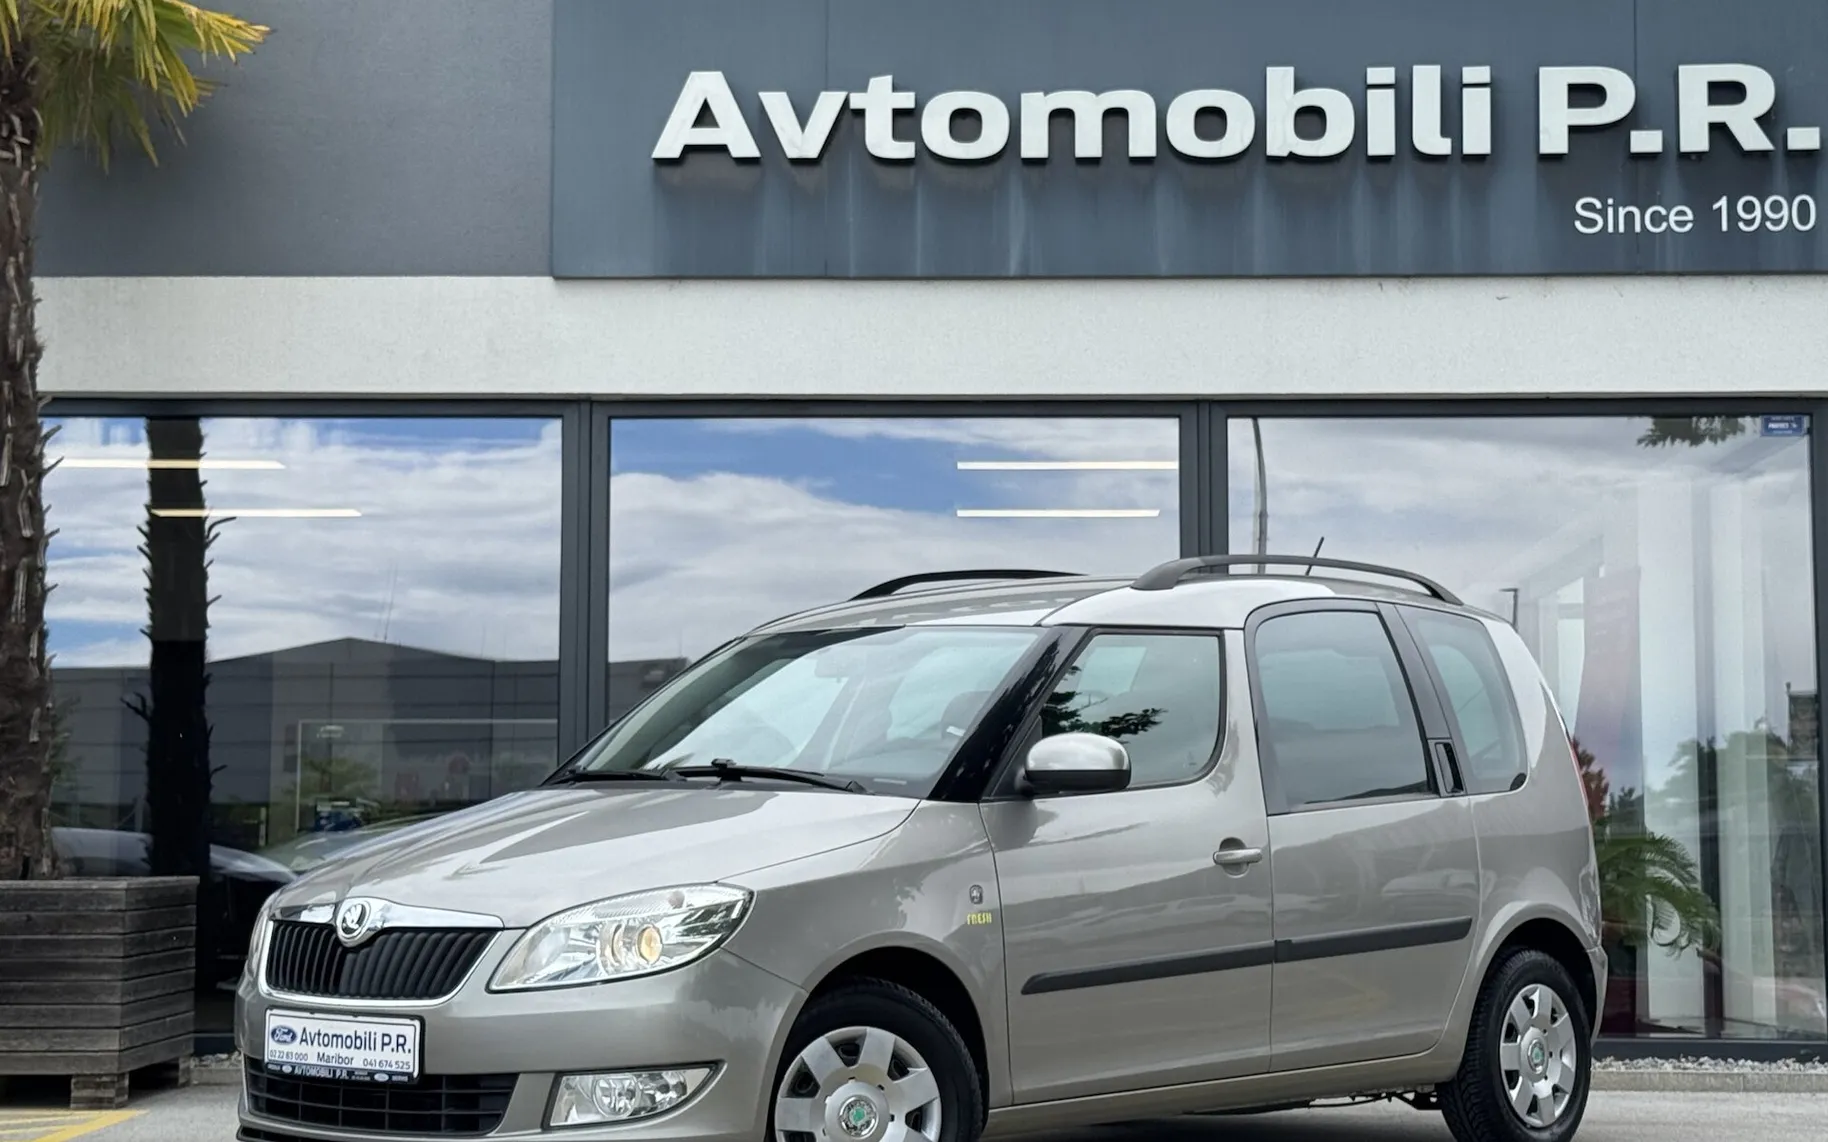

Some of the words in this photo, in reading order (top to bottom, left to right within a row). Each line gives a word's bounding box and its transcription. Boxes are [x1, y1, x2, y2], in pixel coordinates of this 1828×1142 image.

[651, 64, 1491, 160] Avtomobili
[1538, 63, 1820, 154] P.R.
[1574, 197, 1694, 233] Since
[1712, 194, 1817, 232] 1990
[274, 1027, 294, 1042] Ford
[299, 1027, 377, 1052] Avtomobili
[380, 1033, 412, 1054] P.R.
[295, 1052, 309, 1062] 000
[317, 1052, 354, 1066] Maribor
[363, 1058, 377, 1068] 041
[378, 1059, 393, 1069] 674
[395, 1060, 411, 1070] 525
